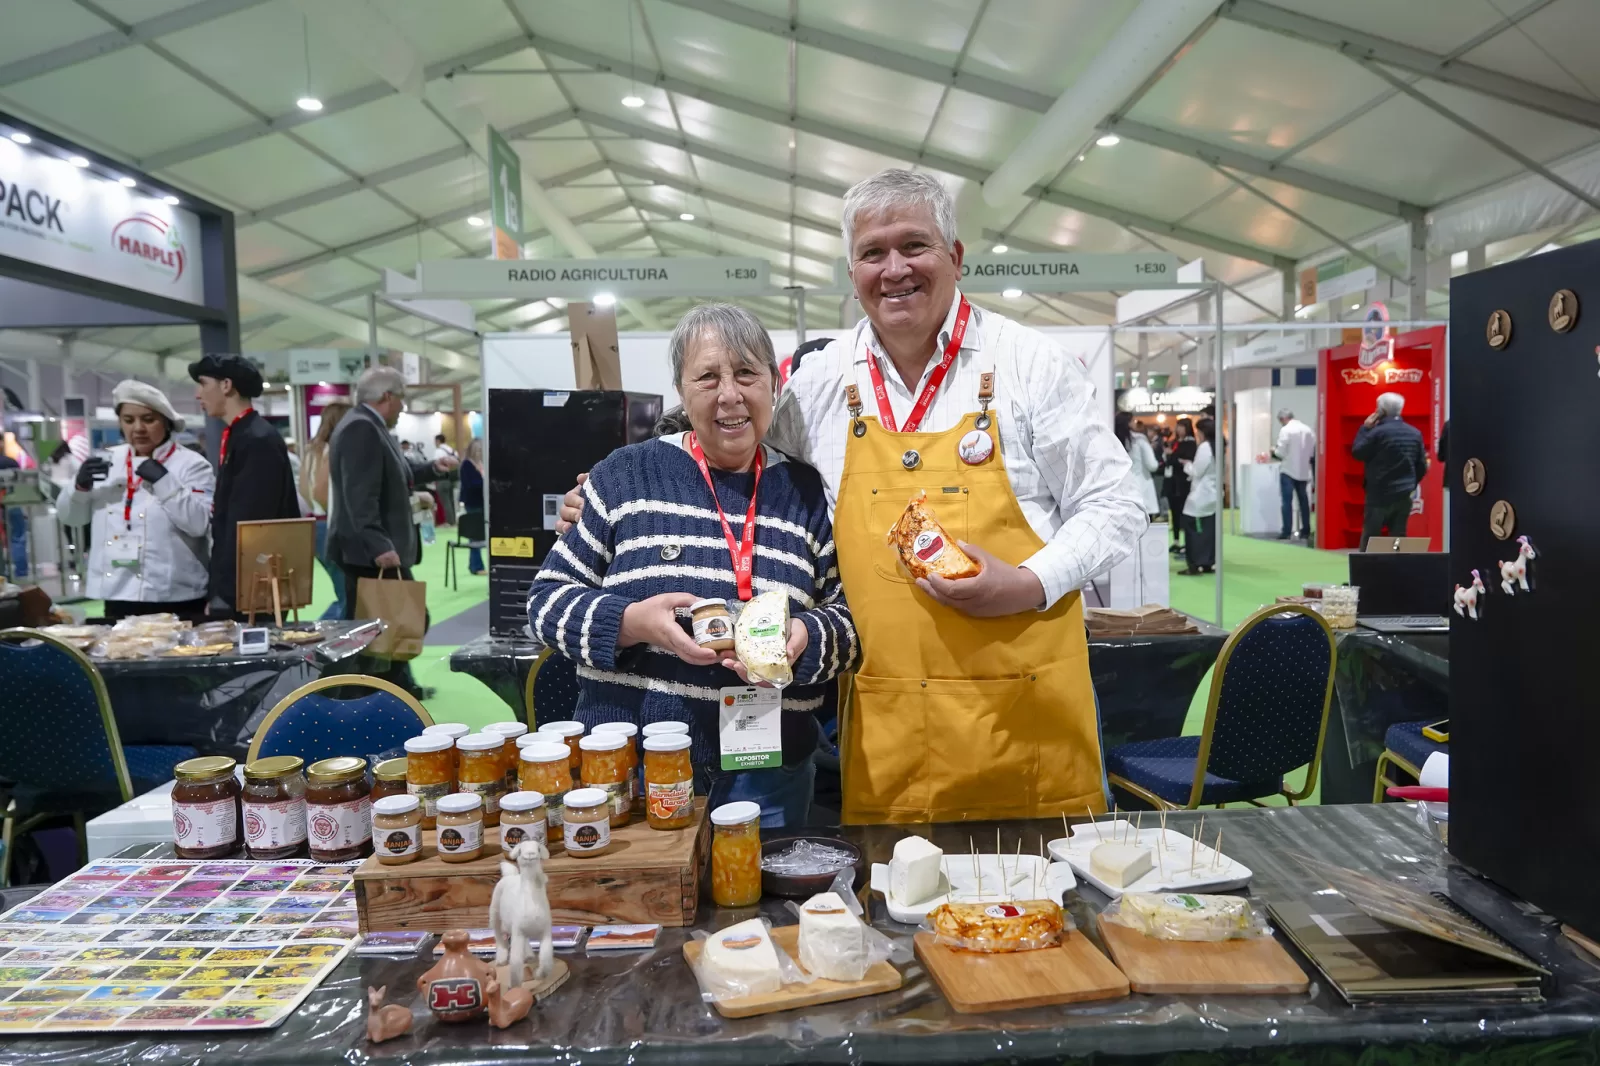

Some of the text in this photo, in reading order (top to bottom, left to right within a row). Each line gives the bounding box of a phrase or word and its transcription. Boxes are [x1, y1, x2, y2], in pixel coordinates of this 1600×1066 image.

[0, 179, 65, 233] ACK
[119, 235, 175, 268] MARPLE
[508, 267, 669, 281] RADIO AGRICULTURA
[725, 268, 757, 279] 1-E30
[974, 263, 1080, 277] AGRICULTURA
[1135, 262, 1166, 273] 1-E30
[735, 754, 770, 762] EXPOSITOR
